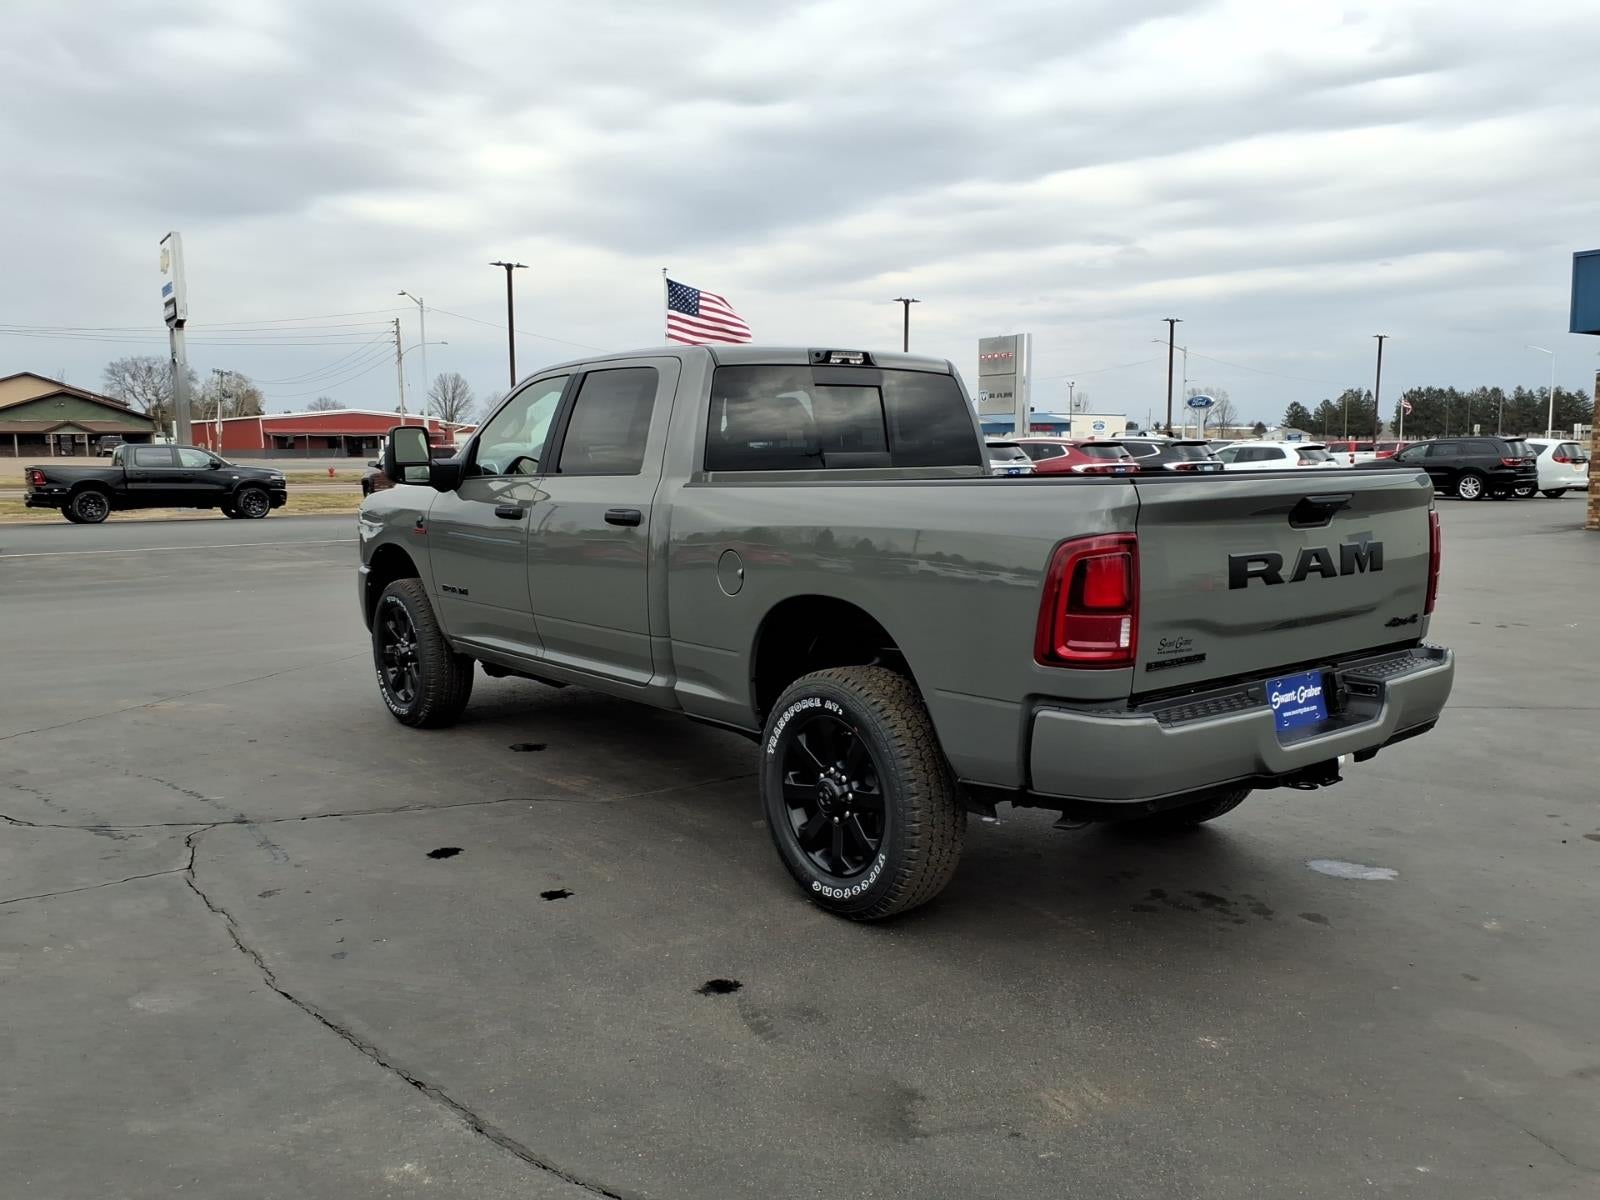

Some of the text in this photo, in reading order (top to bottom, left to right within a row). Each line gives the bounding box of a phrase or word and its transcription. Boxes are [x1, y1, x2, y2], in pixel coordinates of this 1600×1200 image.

[980, 352, 1013, 361] DODGE
[988, 391, 1013, 399] RAM
[1228, 541, 1383, 590] RAM
[1271, 685, 1321, 709] Swant Graber
[767, 698, 822, 754] TRANSFORCE
